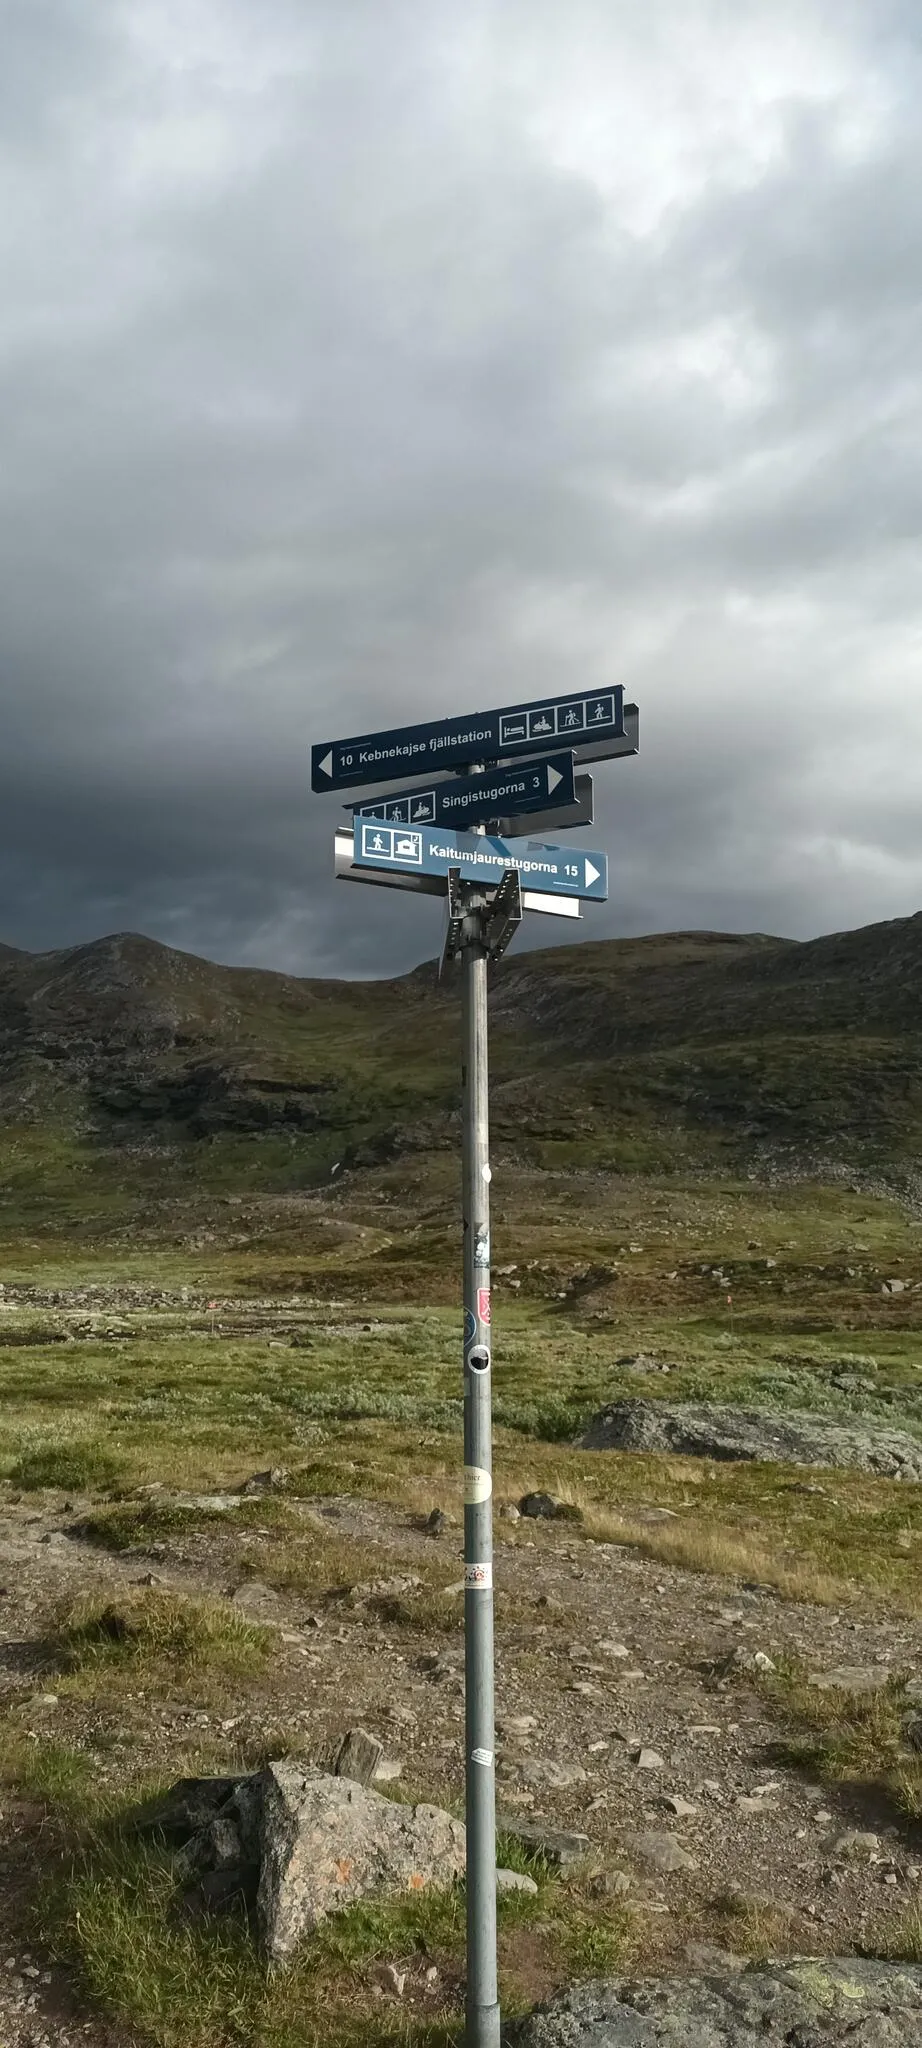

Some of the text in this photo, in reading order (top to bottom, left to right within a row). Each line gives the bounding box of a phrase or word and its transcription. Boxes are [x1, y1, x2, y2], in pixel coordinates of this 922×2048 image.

[340, 730, 492, 766] 10 Kebnekajse fjällstation
[442, 776, 540, 808] Singistugorna 3
[429, 844, 578, 876] Kaitumjaurestugorna 15
